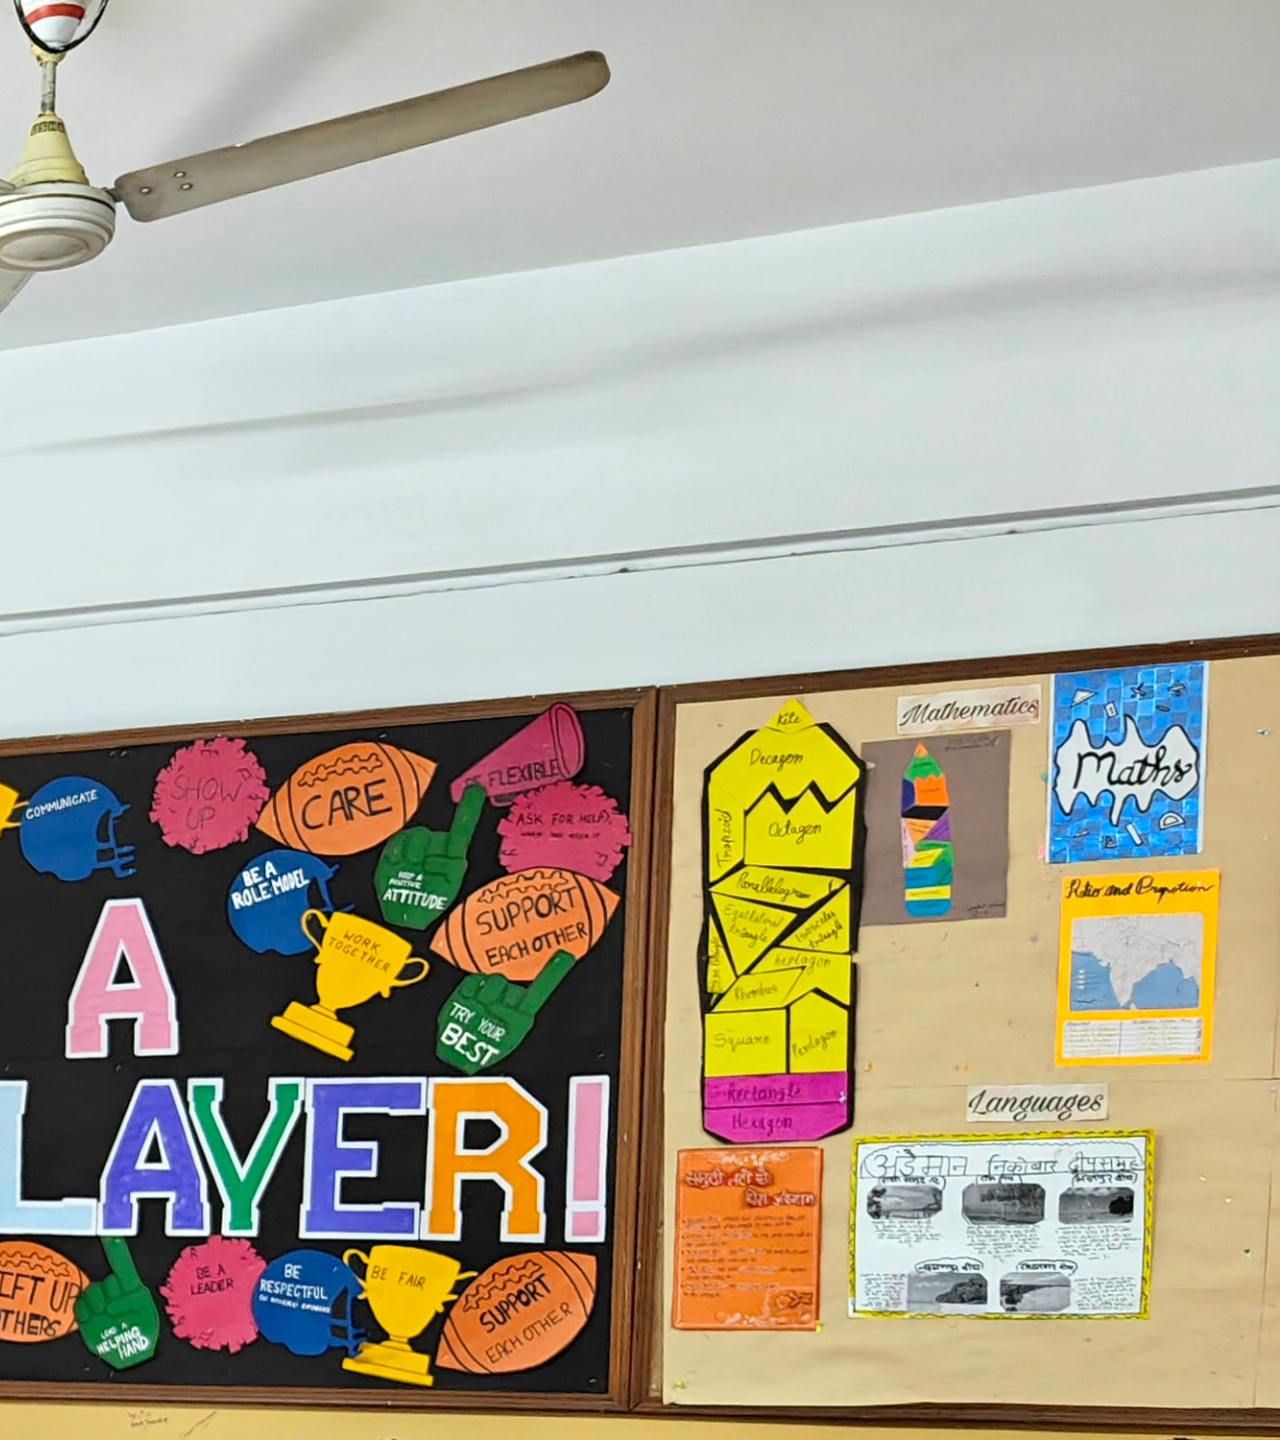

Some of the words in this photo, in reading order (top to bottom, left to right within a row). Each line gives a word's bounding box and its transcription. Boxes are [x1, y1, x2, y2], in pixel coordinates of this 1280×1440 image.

[898, 696, 1039, 728] Mathematics
[488, 758, 561, 788] FLEXIBLE
[749, 748, 804, 772] Decagon
[1073, 744, 1193, 790] Maths
[170, 767, 242, 802] SHOW
[25, 788, 99, 821] COMMUNICATE
[185, 806, 216, 831] UP
[301, 778, 392, 830] CARE
[515, 812, 542, 827] ASK
[551, 811, 574, 826] FOR
[231, 881, 271, 910] ROLE
[270, 867, 310, 895] MODEL
[242, 866, 263, 888] BE
[264, 860, 278, 877] A
[382, 888, 448, 911] ATTITUDE
[476, 886, 579, 936] SUPPORT
[328, 935, 391, 976] TOGETHER
[342, 929, 381, 955] WORK
[486, 938, 529, 968] EACH
[532, 921, 588, 954] OTHER
[65, 898, 179, 1059] A
[449, 1001, 474, 1025] TRY
[477, 1017, 507, 1042] YOUR
[440, 1022, 500, 1066] BEST
[967, 1089, 1104, 1121] Languages
[190, 1278, 234, 1295] LEADER
[197, 1267, 211, 1280] BE
[217, 1264, 227, 1276] A
[283, 1263, 302, 1279] BE
[371, 1264, 389, 1282] BE
[398, 1270, 427, 1291] FAIR
[48, 1280, 82, 1315] UP
[259, 1278, 328, 1300] RESPECTFUL
[479, 1272, 553, 1334] SUPPORT
[96, 1325, 142, 1356] HELPING
[119, 1335, 150, 1360] HAND
[485, 1332, 524, 1365] EACH
[523, 1301, 574, 1344] OTHER
